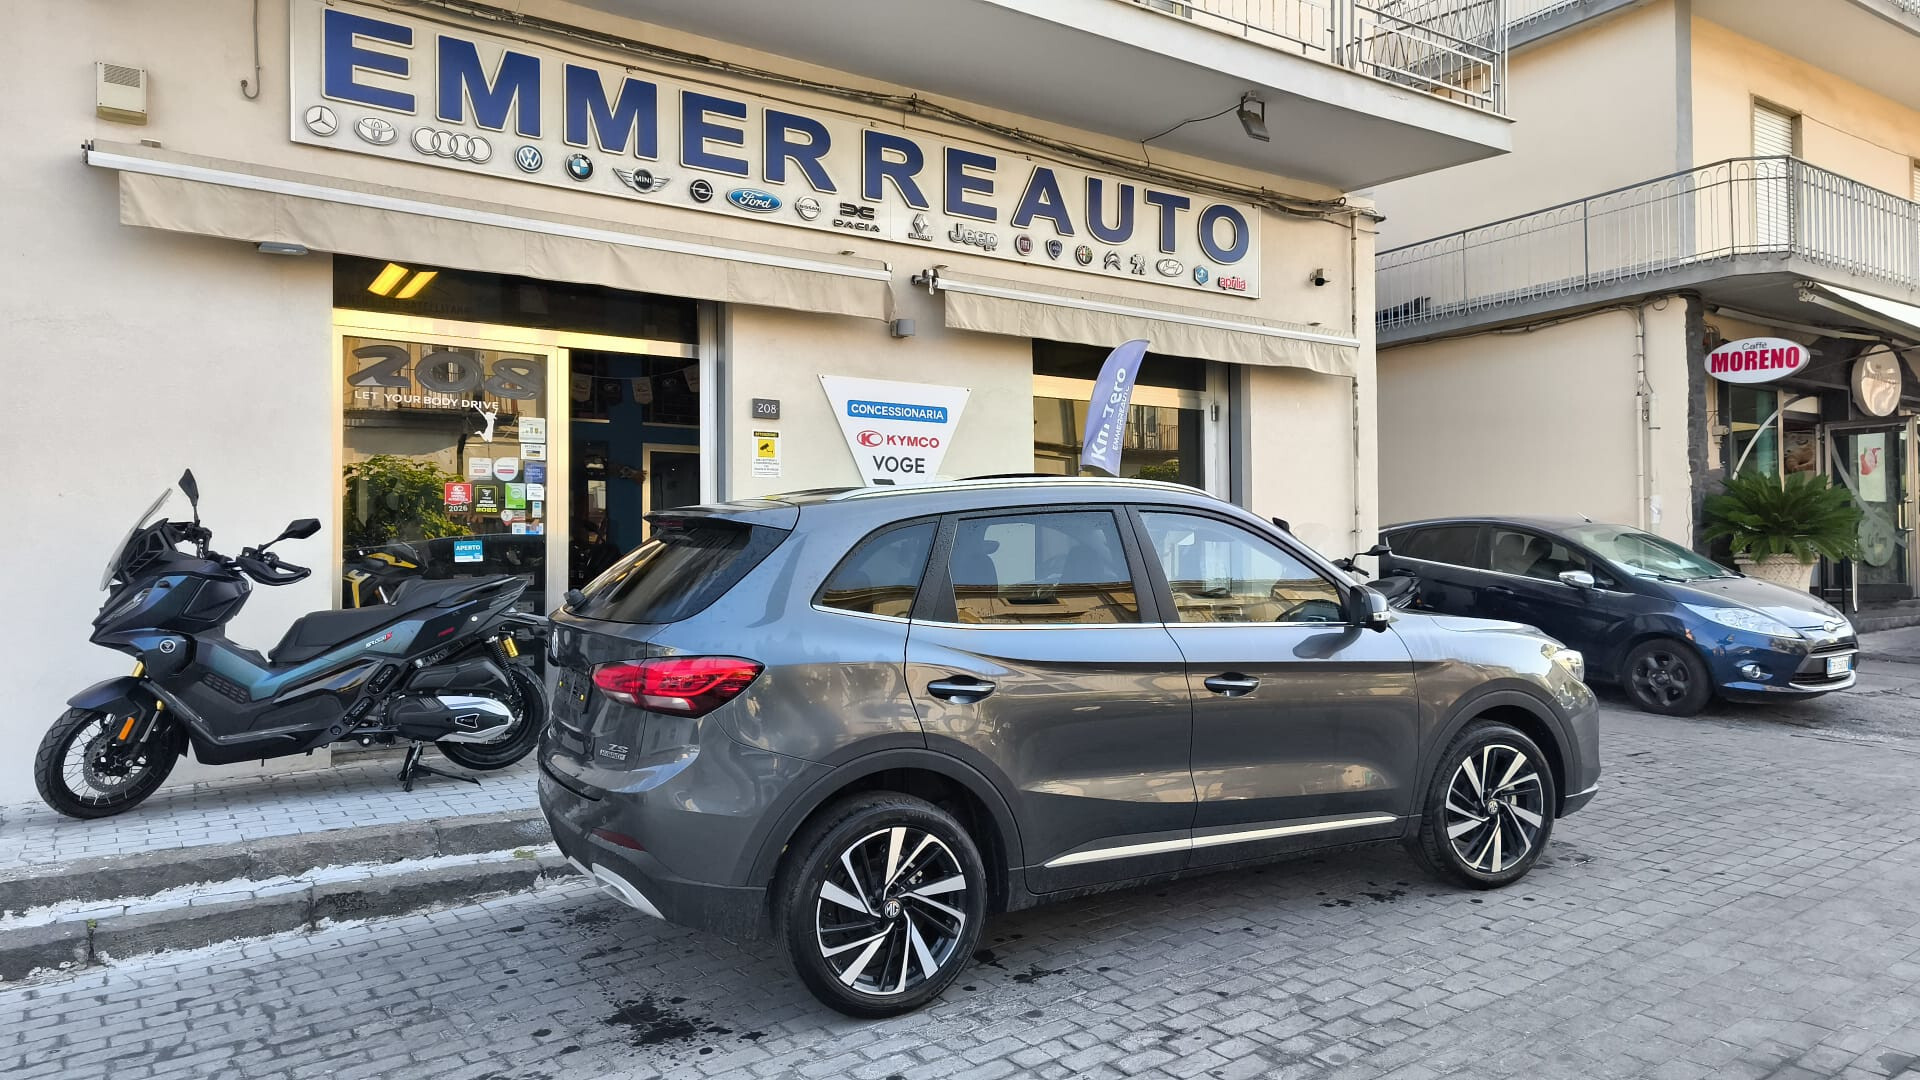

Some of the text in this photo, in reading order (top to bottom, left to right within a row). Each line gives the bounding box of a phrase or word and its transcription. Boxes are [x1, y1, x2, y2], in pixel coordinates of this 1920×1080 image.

[634, 174, 653, 184] MINI
[737, 189, 772, 209] Ford
[832, 218, 880, 233] DACIA
[949, 223, 999, 251] Jeep
[1219, 276, 1247, 291] aprilia
[1711, 346, 1800, 373] MORENO
[347, 345, 544, 401] 208
[355, 390, 499, 410] LET YOUR BODY DRIVE
[758, 403, 777, 414] 208
[851, 404, 944, 421] CONCESSIONARIA
[886, 435, 940, 449] KYMCO
[872, 455, 925, 473] VOGE
[455, 544, 481, 552] APERTO
[609, 744, 629, 753] ZS
